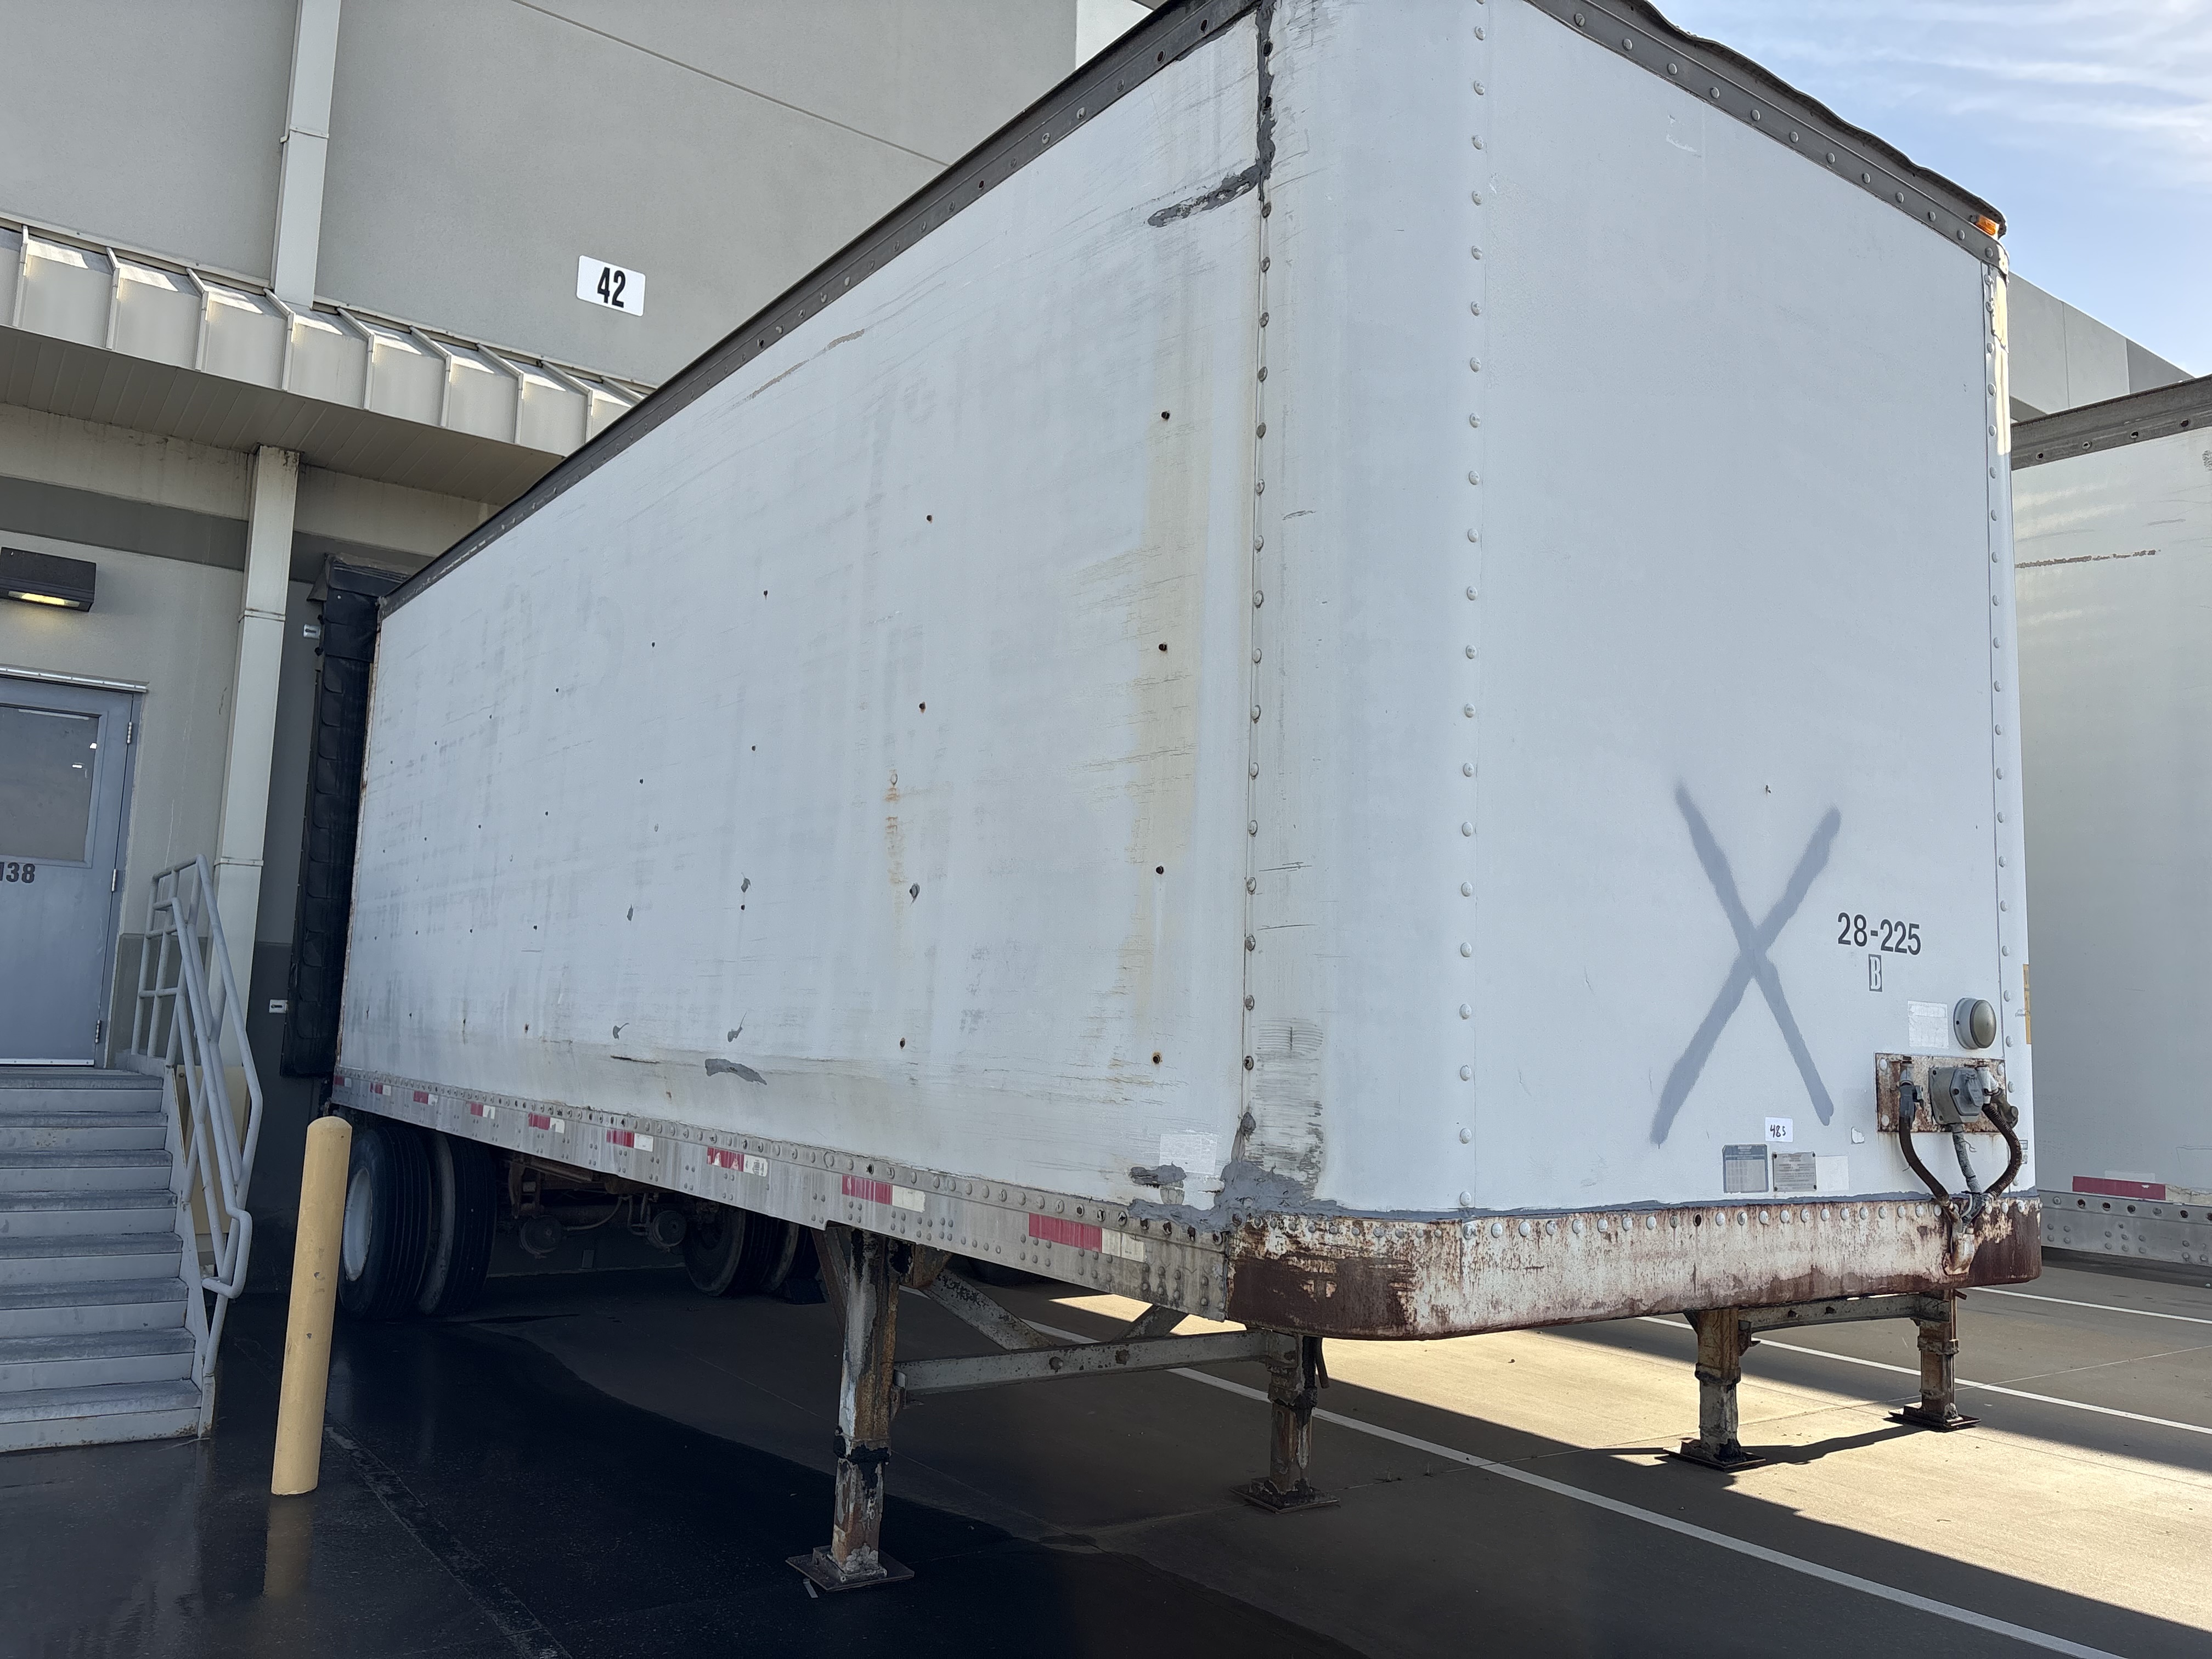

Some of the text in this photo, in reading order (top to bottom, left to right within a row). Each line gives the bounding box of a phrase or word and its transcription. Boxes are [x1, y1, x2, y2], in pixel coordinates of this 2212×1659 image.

[597, 266, 626, 308] 42
[1838, 912, 1921, 956] 28-225
[1770, 1124, 1786, 1138] 485
